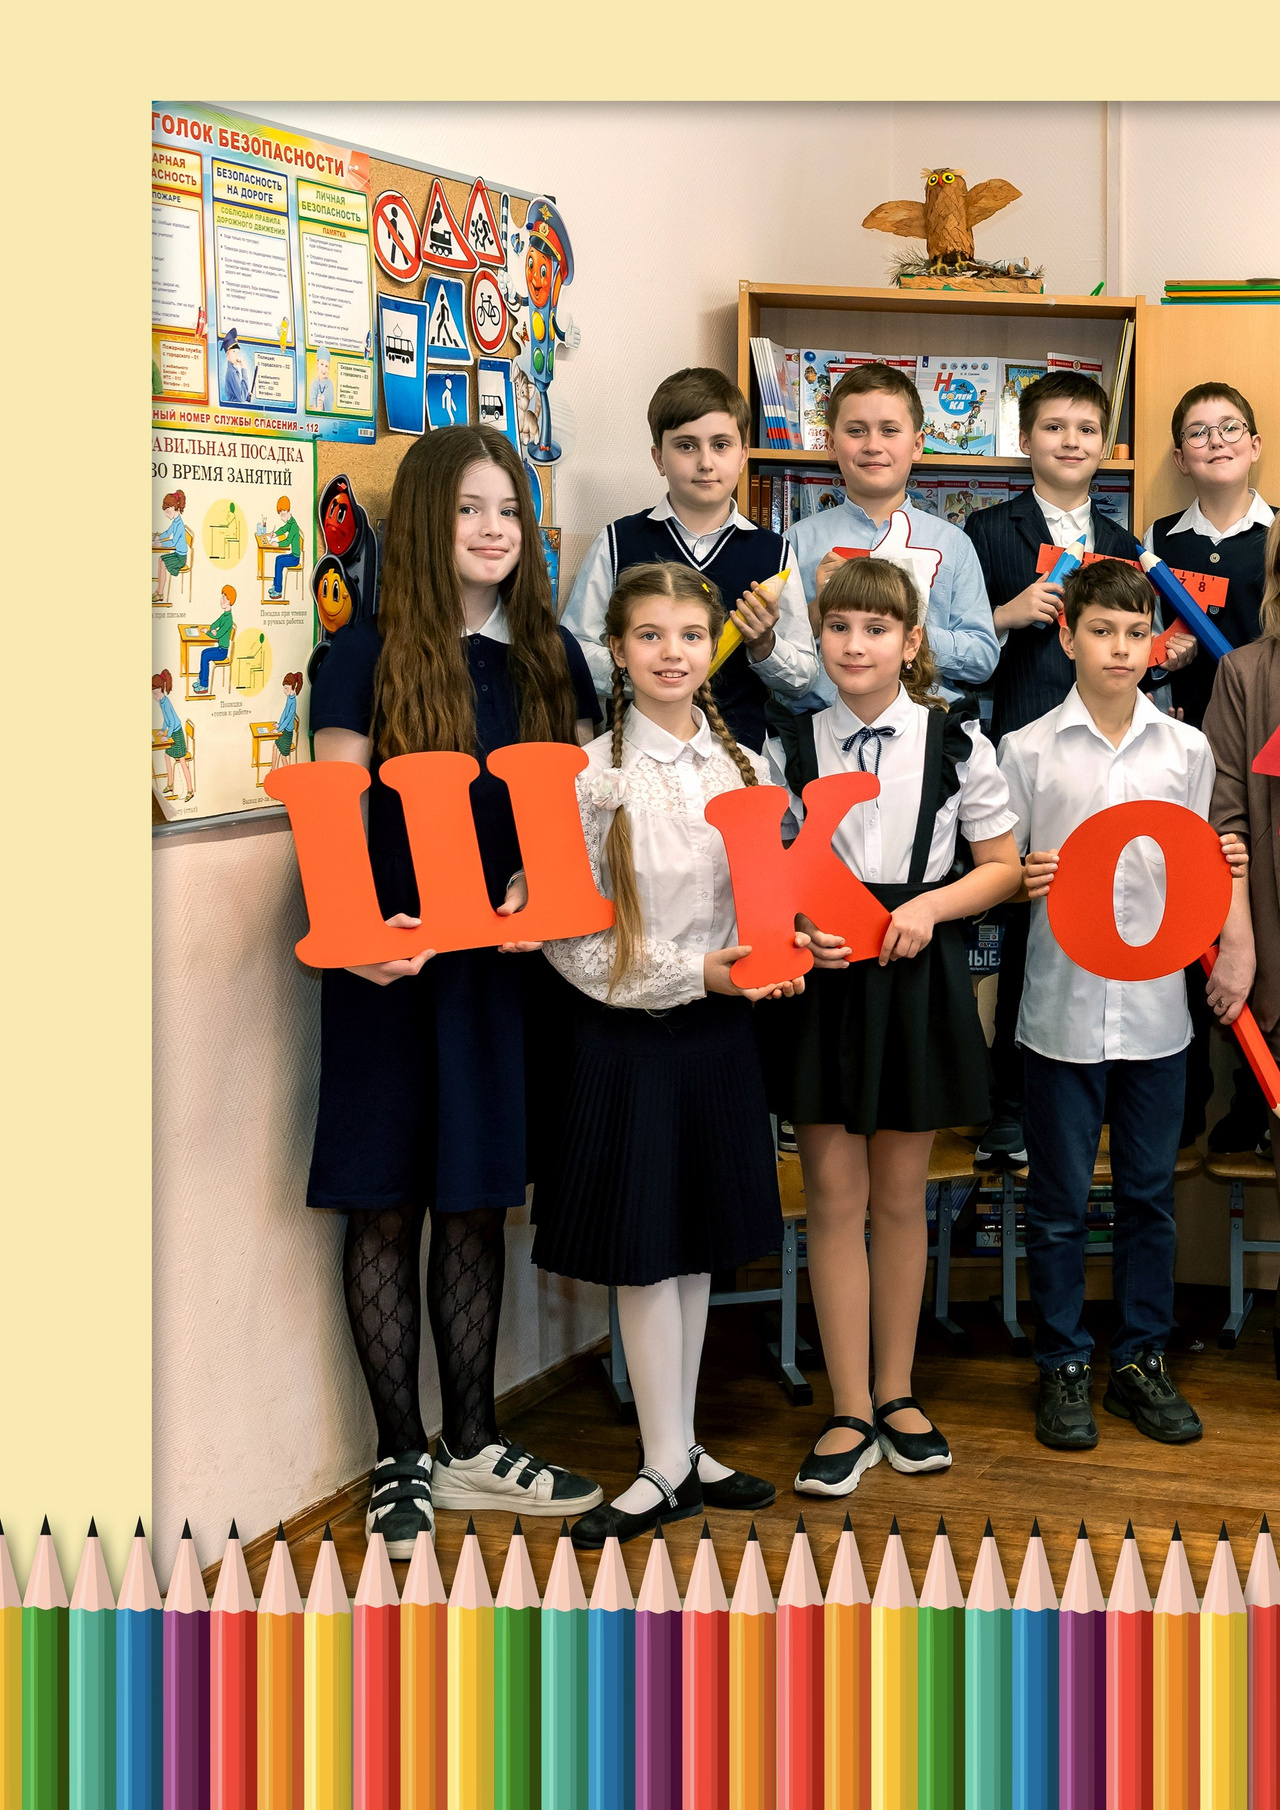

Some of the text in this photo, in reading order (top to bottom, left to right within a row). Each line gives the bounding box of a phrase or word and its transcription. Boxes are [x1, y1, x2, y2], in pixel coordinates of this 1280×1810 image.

[219, 127, 345, 177] БЕЗОПАСНОСТИ
[217, 167, 283, 191] БЕЗОПАСНОСТЬ
[227, 184, 274, 204] НА ДОРОГЕ
[316, 190, 346, 206] ЛИЧНАЯ
[255, 211, 282, 226] ПРАВИЛА
[301, 202, 361, 222] БЕЗОПАСНОСТЬ
[217, 215, 287, 236] ДОРОЖНОГО ДВИЖЕНИЯ
[322, 226, 348, 239] ПАМЯТКА
[180, 412, 210, 424] НОМЕР
[214, 415, 252, 427] СЛУЖБЫ
[254, 418, 298, 431] СПАСЕНИЯ
[306, 423, 319, 432] 112
[152, 437, 304, 464] АВИЛЬНАЯ ПОСАДКА
[172, 463, 223, 482] ВРЕМЯ
[228, 468, 292, 486] ЗАНЯТИЙ
[1198, 582, 1206, 592] 8
